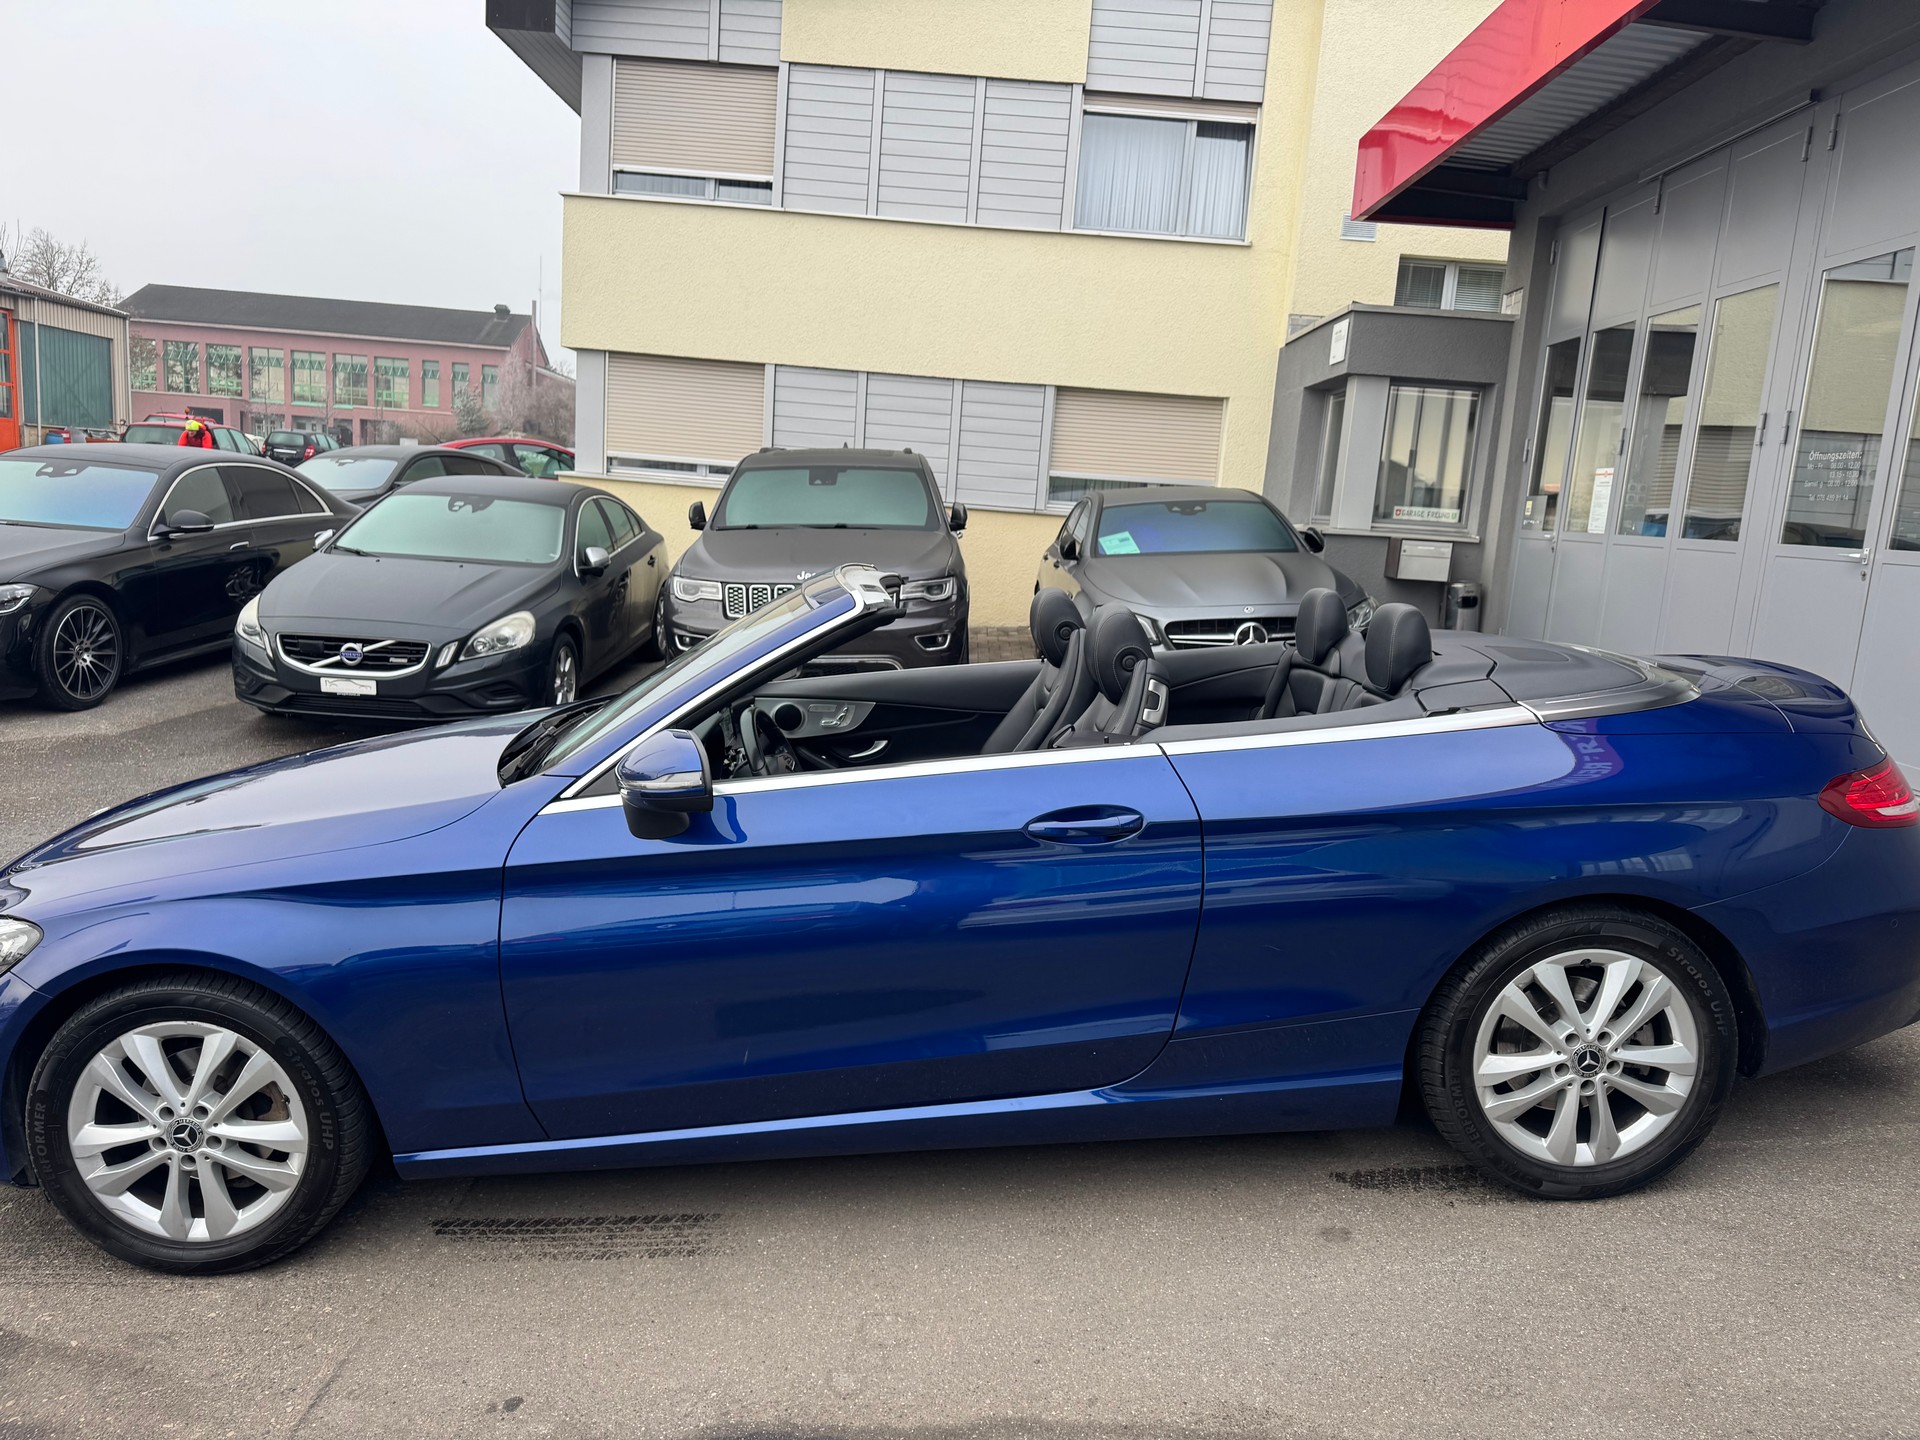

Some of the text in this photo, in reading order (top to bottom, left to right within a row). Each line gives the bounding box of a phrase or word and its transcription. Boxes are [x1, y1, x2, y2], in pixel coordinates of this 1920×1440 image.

[1402, 509, 1425, 518] GARAGE
[1667, 947, 1728, 1036] Stratos UHP
[283, 1047, 334, 1150] Stratos UHP
[1449, 1068, 1486, 1147] PERFORMER
[34, 1103, 61, 1191] PERFORMER
